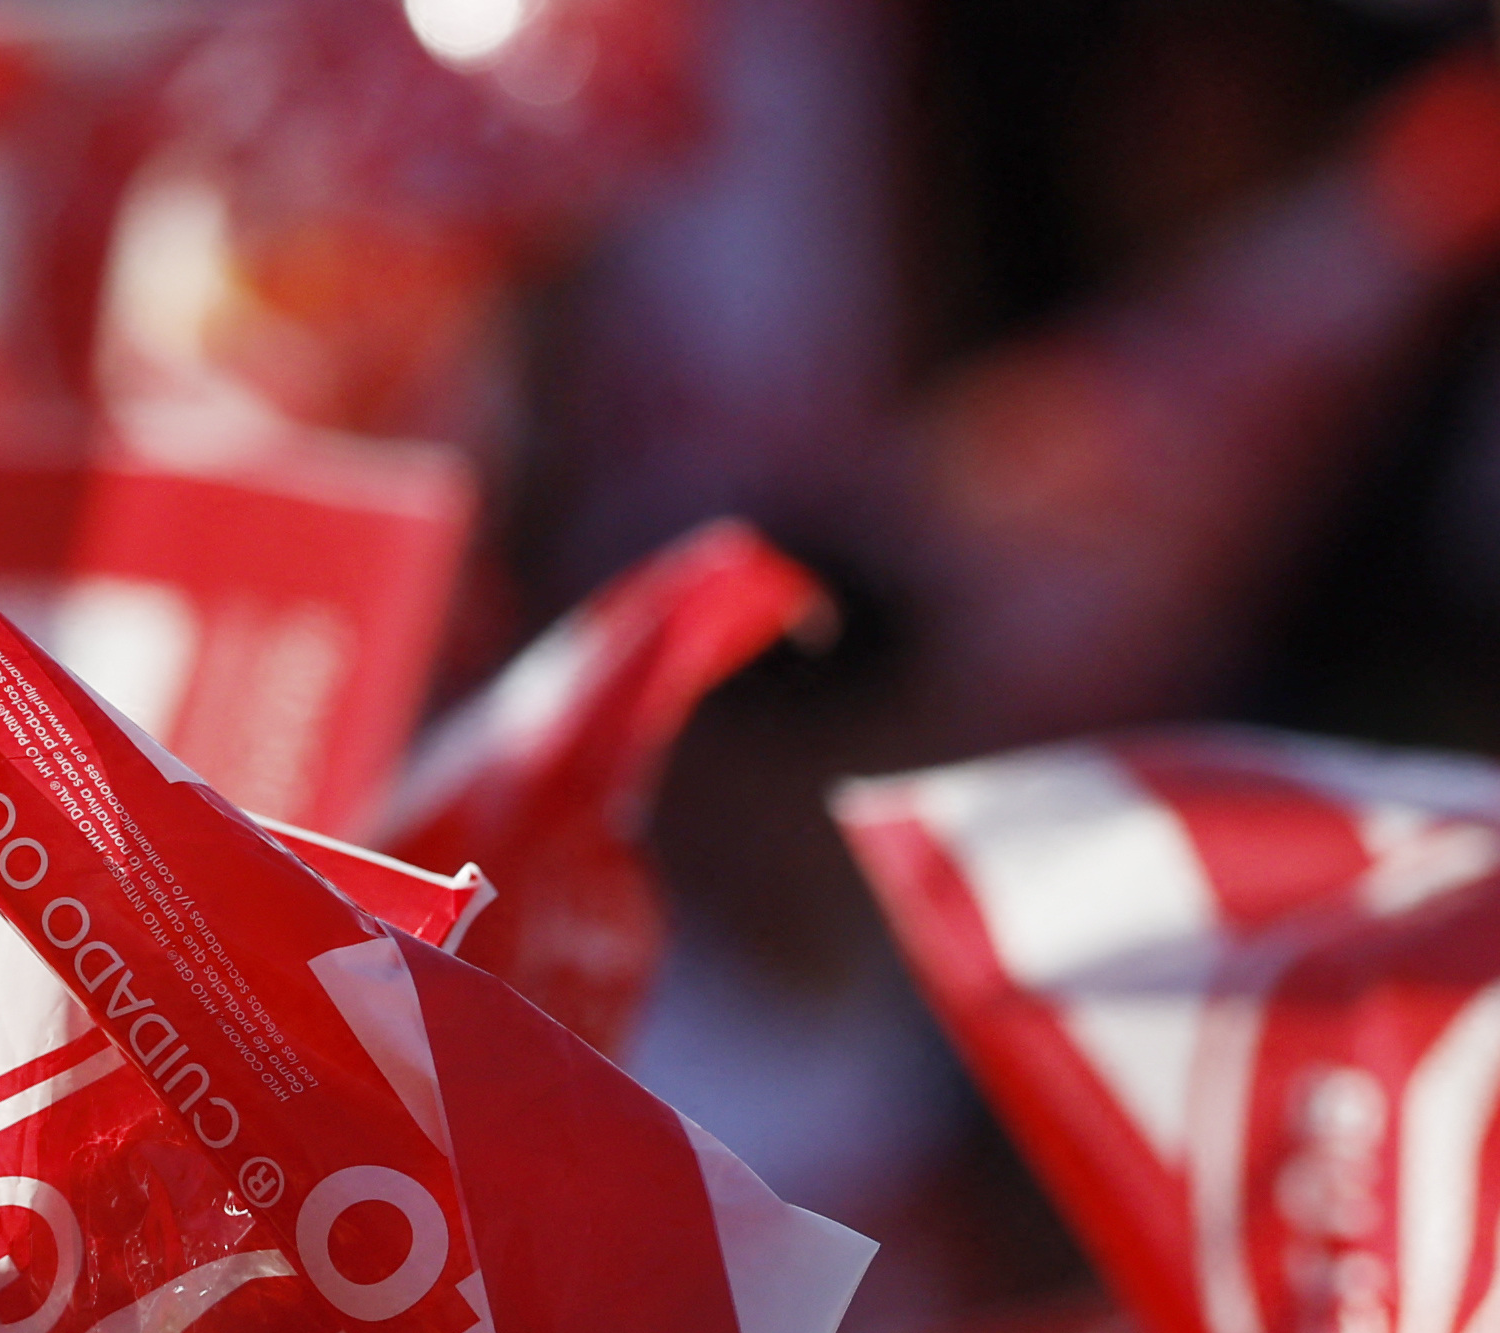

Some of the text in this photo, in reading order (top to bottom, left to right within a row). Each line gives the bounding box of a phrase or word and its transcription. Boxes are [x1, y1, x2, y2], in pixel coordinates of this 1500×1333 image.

[2, 684, 60, 751] productos
[24, 745, 56, 779] HYLO
[52, 750, 85, 788] sobre
[69, 745, 88, 764] en
[77, 819, 108, 853] HYLO
[79, 787, 132, 856] normativa
[83, 763, 175, 884] contraindicaciones
[127, 854, 144, 873] la
[139, 870, 186, 933] cumplen
[171, 884, 196, 911] y/o
[142, 911, 172, 948] HYLO
[182, 934, 207, 964] que
[188, 909, 251, 995] secundarios
[190, 982, 220, 1015] HYLO
[202, 964, 259, 1034] productos
[40, 895, 241, 1150] CUIDADO
[246, 994, 285, 1045] efectos
[252, 1035, 271, 1054] de
[280, 1044, 300, 1066] los
[260, 1072, 291, 1103] HYLO
[267, 1054, 305, 1094] Gama
[296, 1065, 319, 1088] Lea
